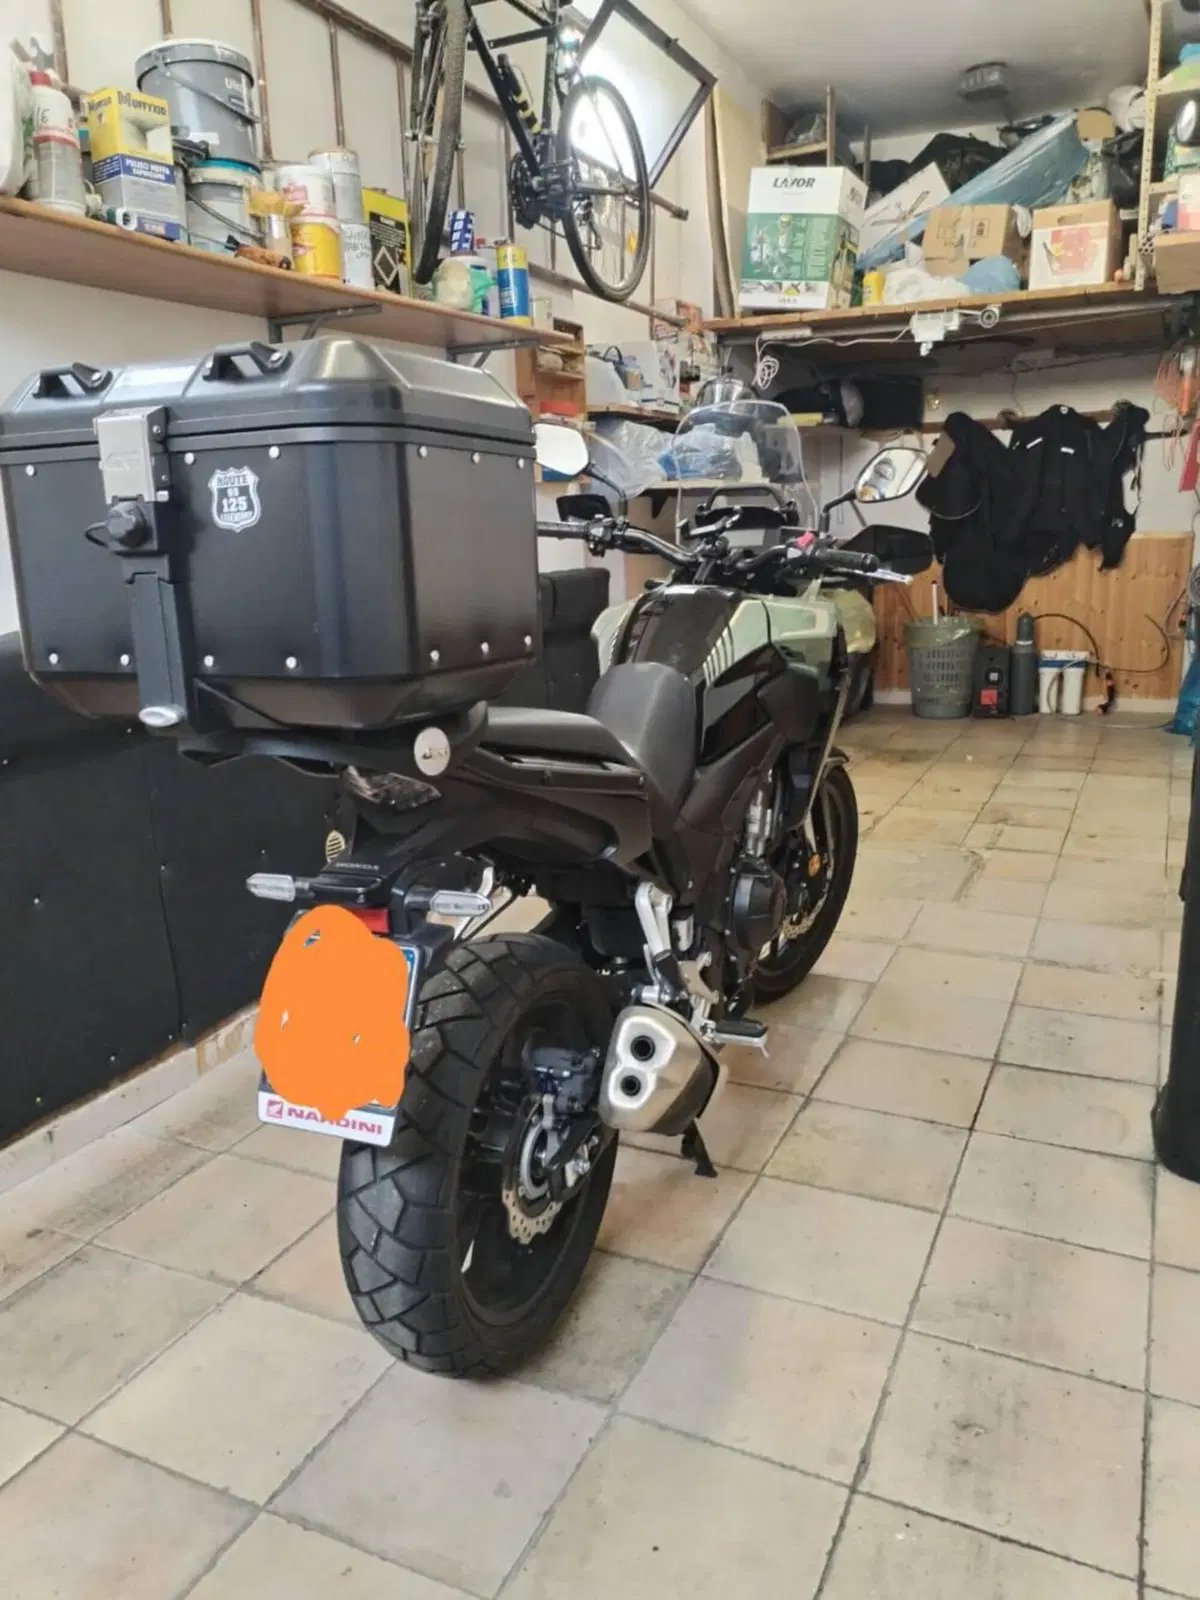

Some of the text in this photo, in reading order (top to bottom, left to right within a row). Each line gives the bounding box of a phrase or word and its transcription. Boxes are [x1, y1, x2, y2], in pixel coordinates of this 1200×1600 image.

[772, 177, 816, 188] LAVOR
[216, 475, 249, 487] ROUTE
[222, 496, 248, 513] 125
[287, 1105, 384, 1135] NADINI
